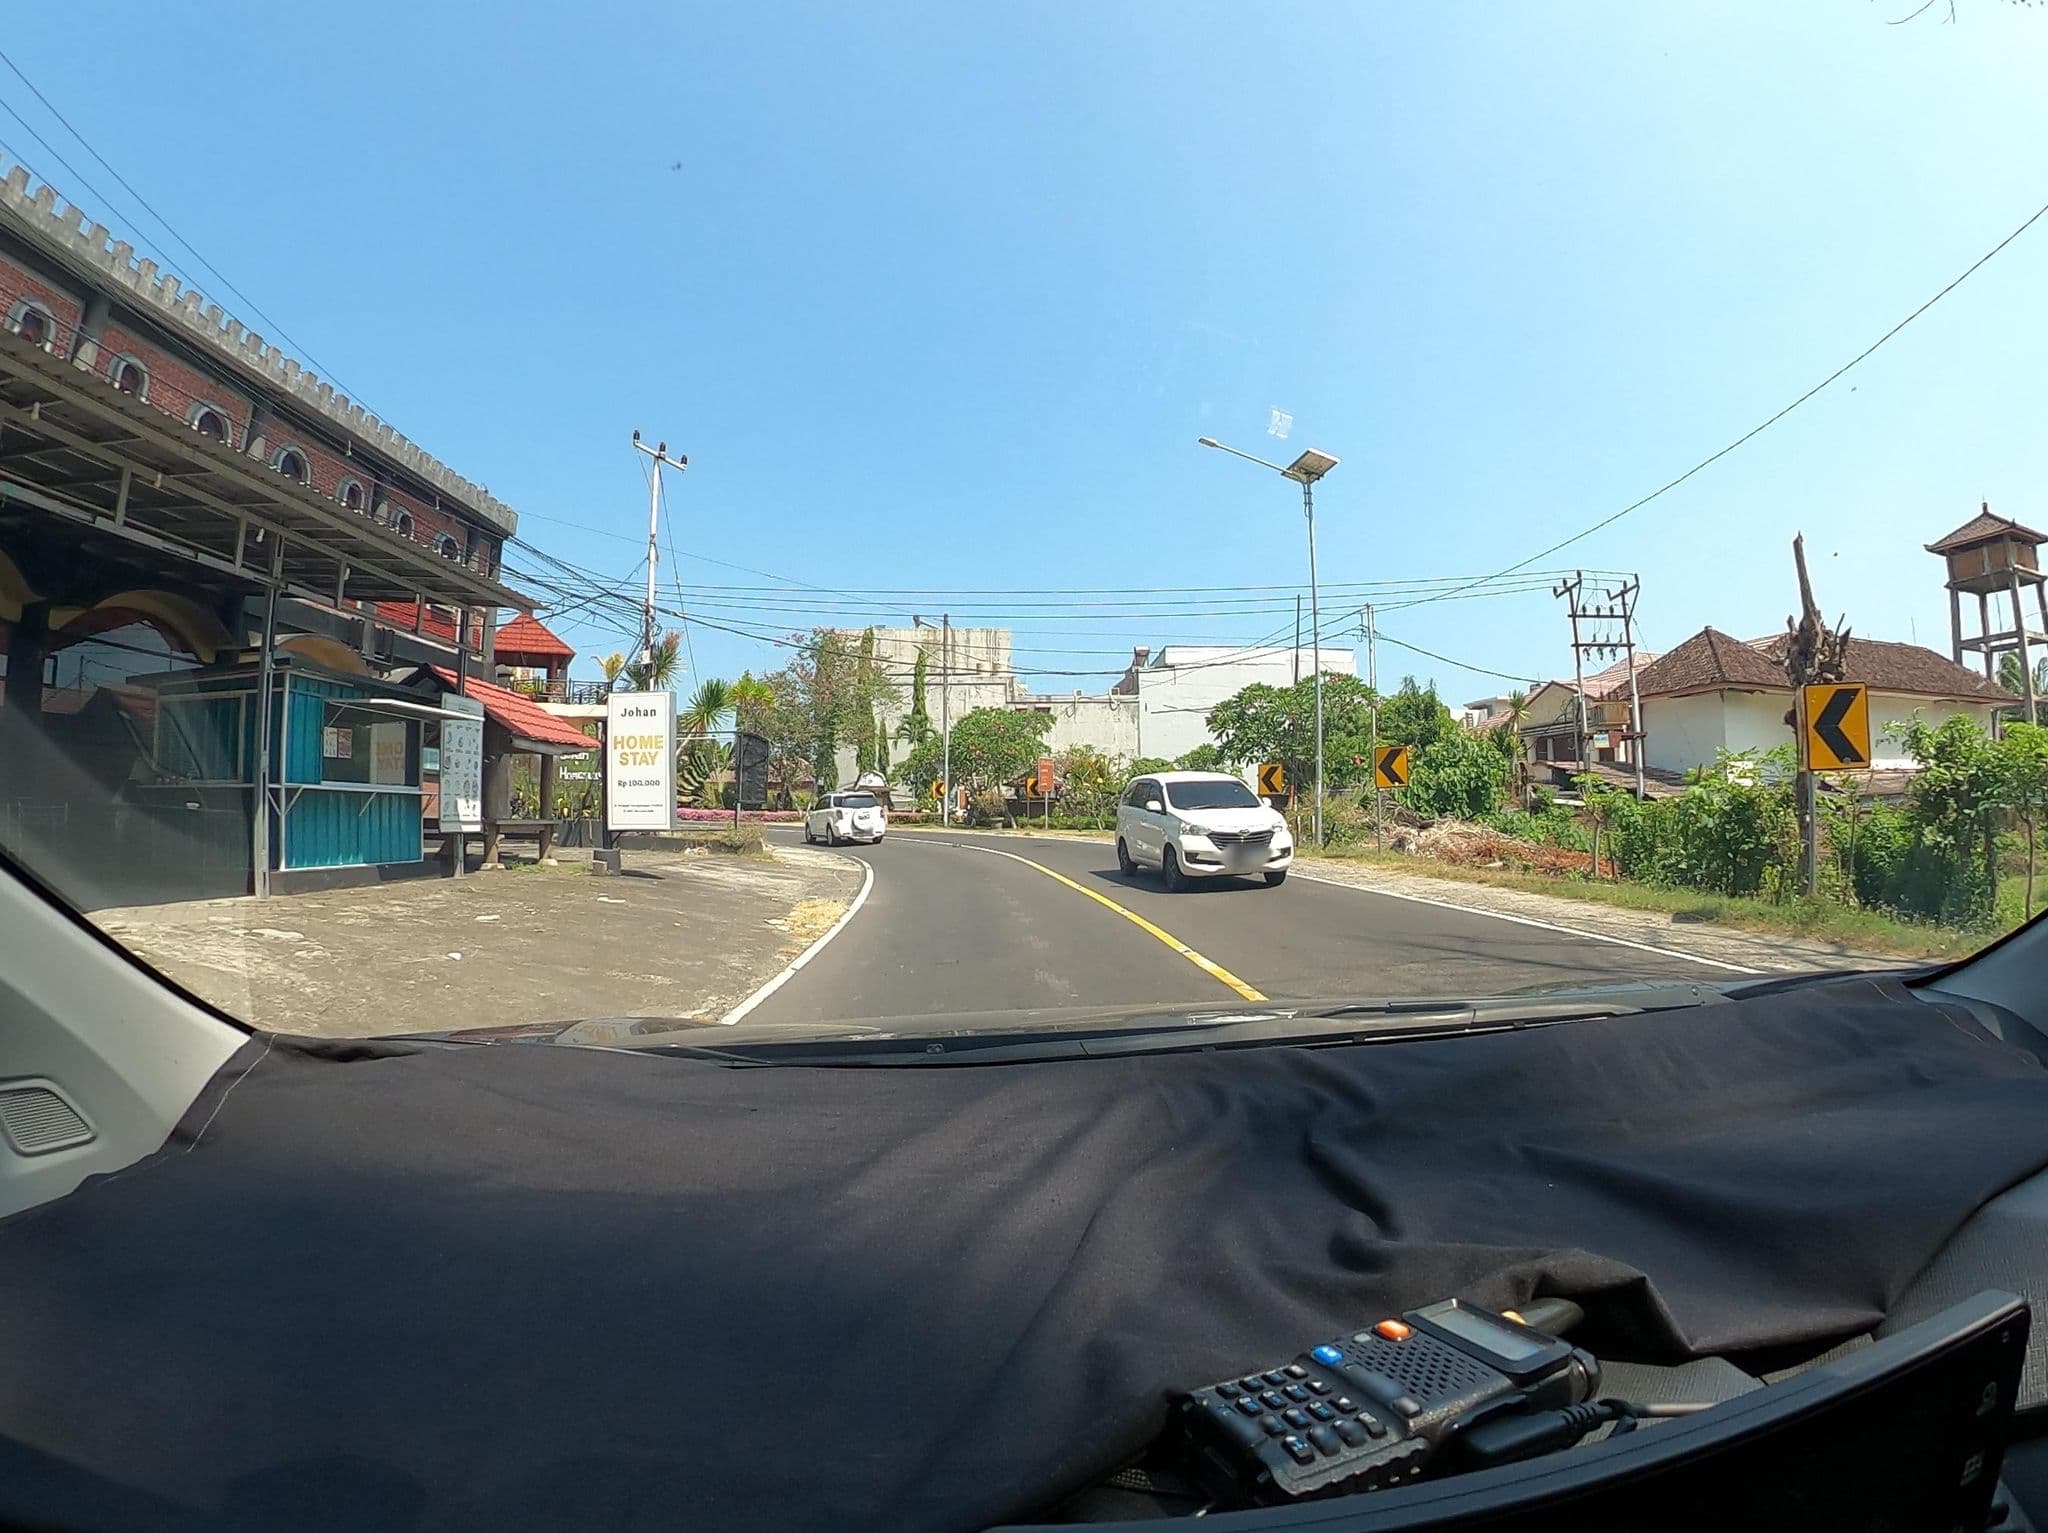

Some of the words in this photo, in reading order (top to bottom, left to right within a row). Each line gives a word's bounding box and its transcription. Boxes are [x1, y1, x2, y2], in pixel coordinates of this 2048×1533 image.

[621, 707, 657, 717] Johan
[613, 735, 664, 750] HOME
[619, 751, 659, 766] STAY
[617, 780, 628, 788] Rp
